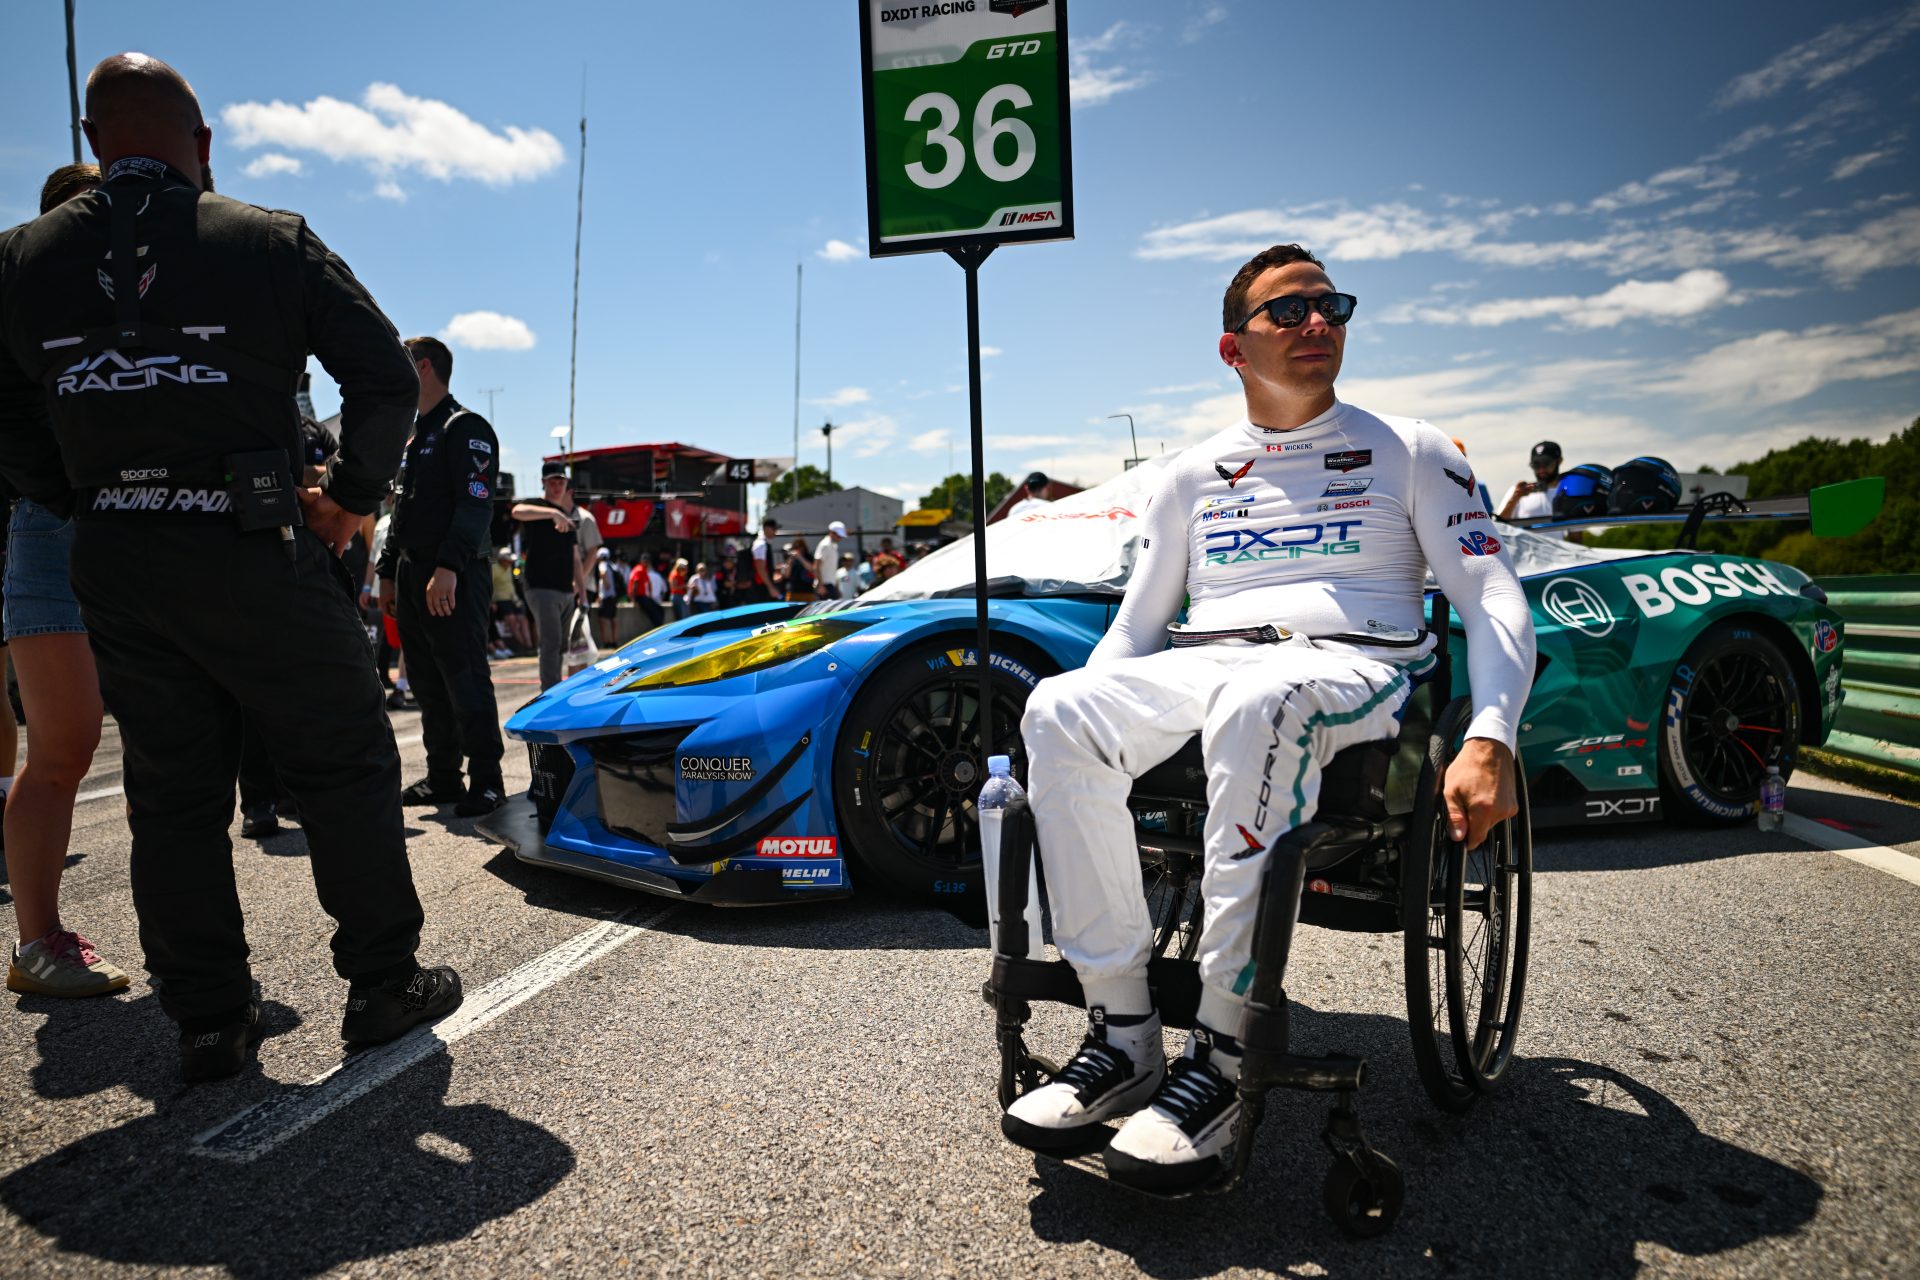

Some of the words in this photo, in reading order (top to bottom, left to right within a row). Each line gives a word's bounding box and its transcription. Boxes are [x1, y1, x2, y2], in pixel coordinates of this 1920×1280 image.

[881, 7, 919, 22] DXDT
[922, 0, 975, 17] RACING
[986, 40, 1041, 60] GTD
[904, 84, 1036, 189] 36
[1017, 210, 1056, 223] IMSA
[57, 365, 228, 396] RACING
[1285, 443, 1313, 451] WICKENS
[121, 468, 168, 481] sparco
[730, 464, 750, 479] 45
[93, 487, 169, 511] RACING
[1335, 500, 1371, 510] BOSCH
[1203, 510, 1234, 521] Mobil
[1206, 520, 1362, 553] DXDT
[1206, 541, 1360, 566] RACING
[1621, 561, 1794, 619] BOSCH
[680, 757, 751, 772] CONQUER
[681, 771, 726, 780] PARALYSIS
[727, 771, 752, 780] NOW
[1585, 797, 1660, 817] DXDT
[1688, 787, 1745, 818] MICHELIN
[760, 839, 834, 854] MOTUL
[782, 868, 831, 878] HELIN
